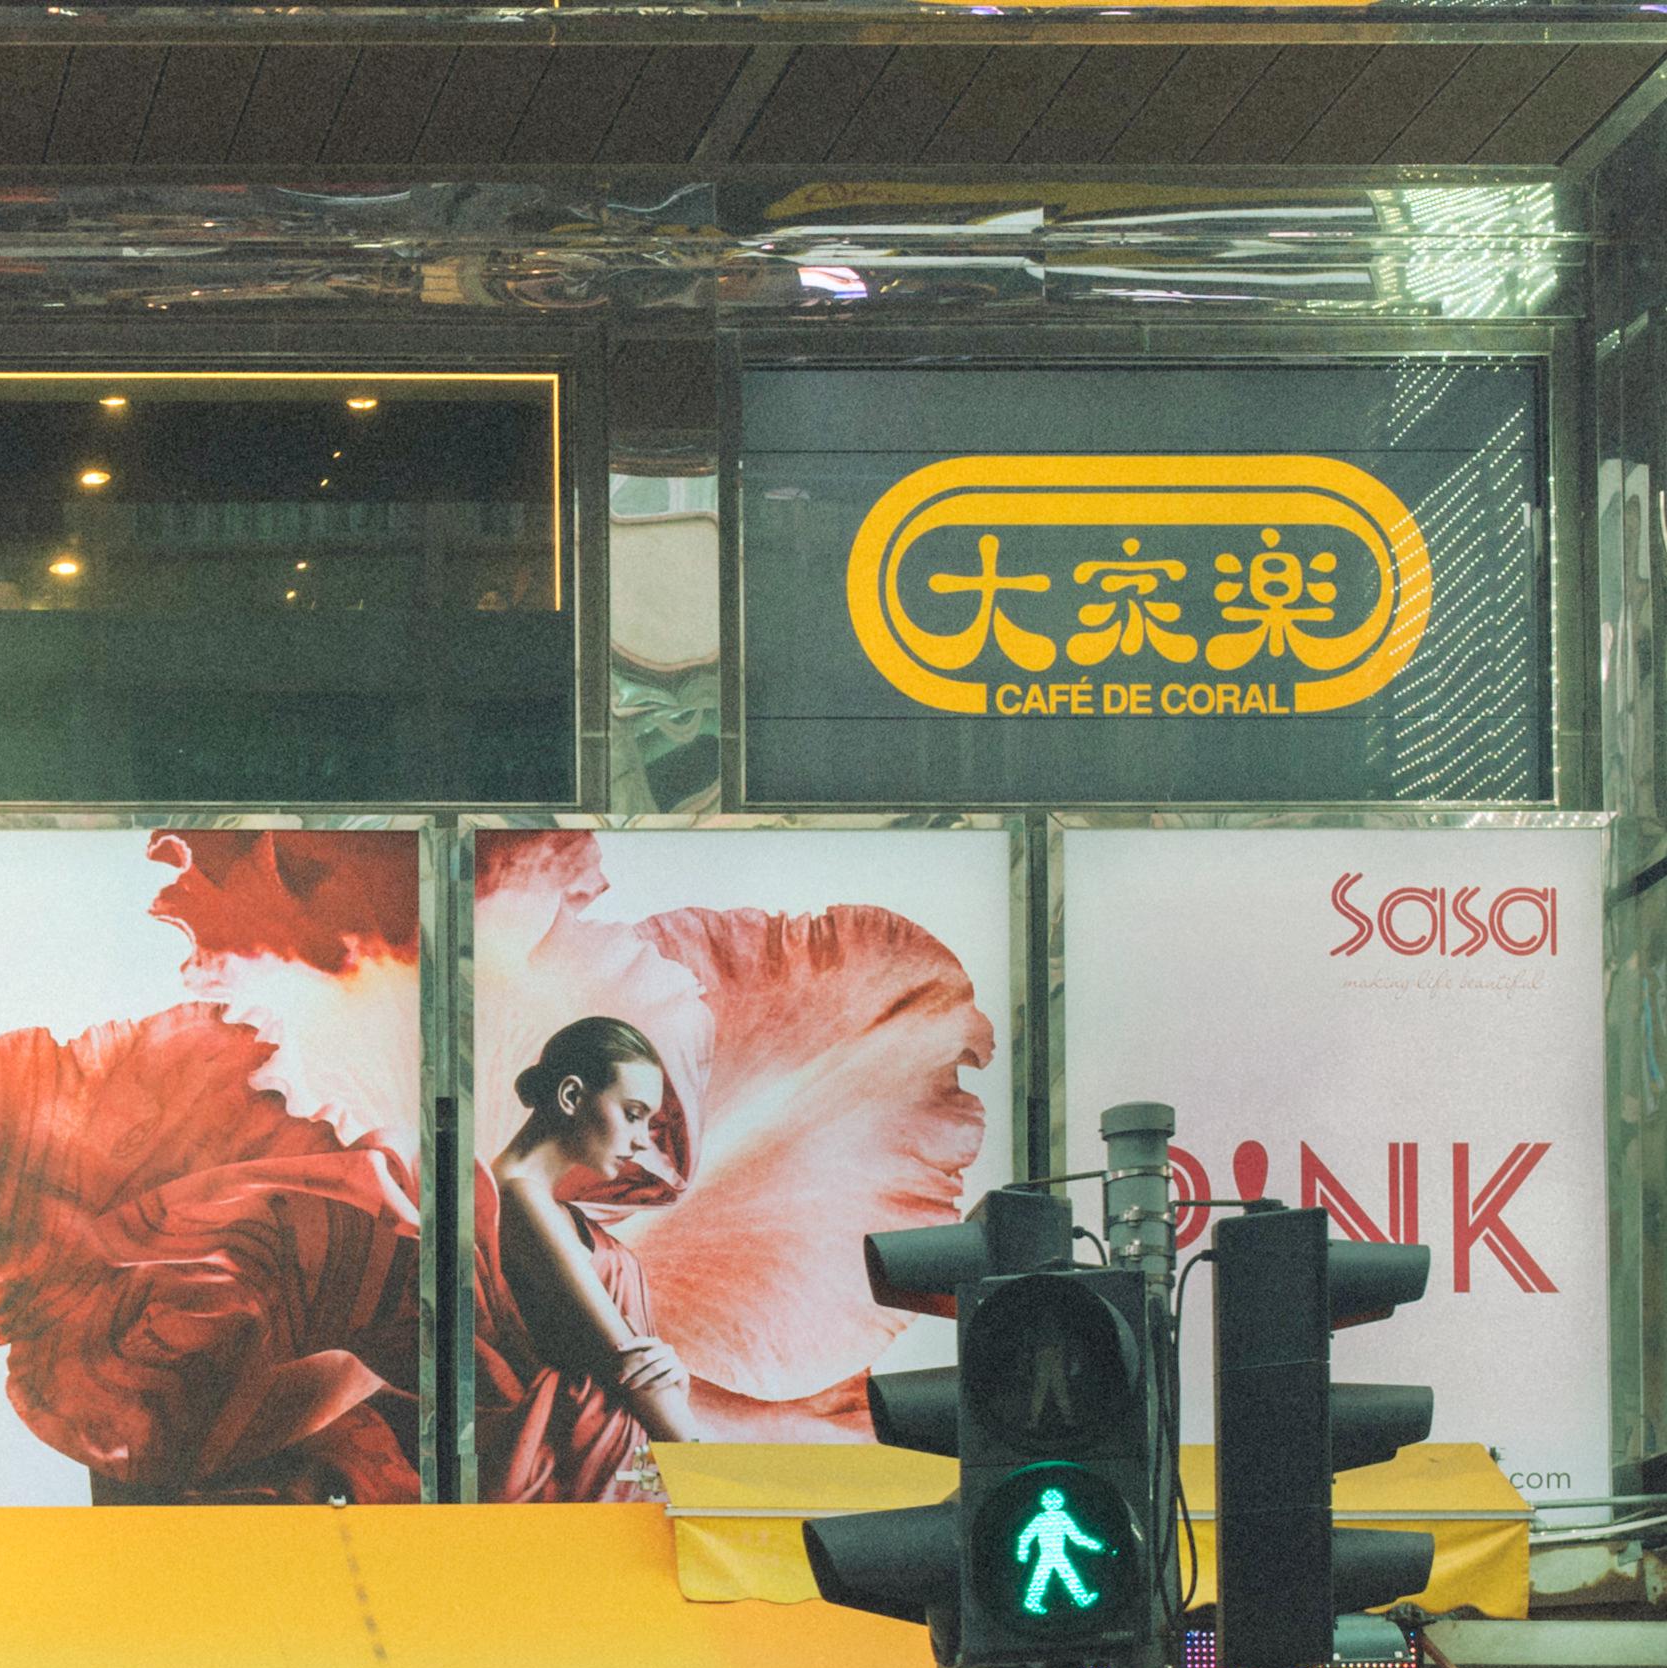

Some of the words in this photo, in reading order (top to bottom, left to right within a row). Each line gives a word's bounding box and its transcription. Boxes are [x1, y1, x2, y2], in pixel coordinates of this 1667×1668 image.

[995, 676, 1093, 714] CAFÉ
[1103, 684, 1152, 714] DE
[1160, 683, 1290, 715] CORAL
